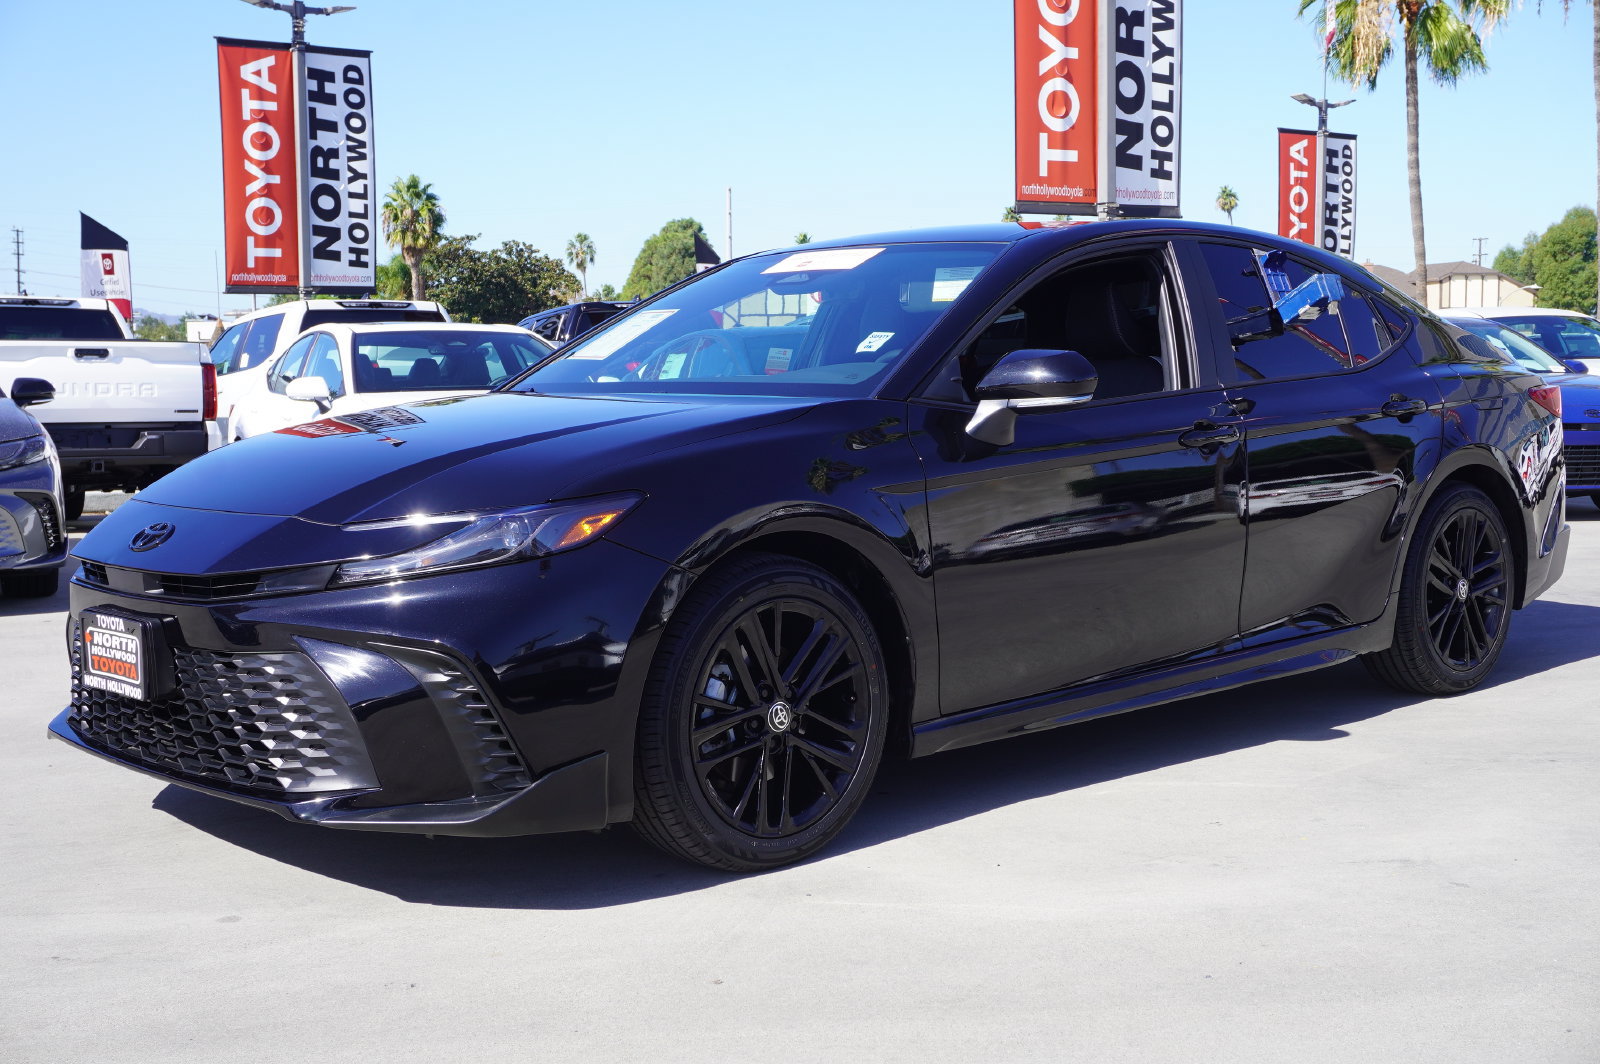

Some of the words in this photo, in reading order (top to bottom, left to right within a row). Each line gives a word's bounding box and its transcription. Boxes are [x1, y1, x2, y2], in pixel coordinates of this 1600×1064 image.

[240, 55, 283, 268] TOYOTA
[307, 67, 341, 262] NORTH
[343, 64, 370, 269] HOLLYWOOD
[1289, 138, 1308, 240] YOTA
[1324, 147, 1339, 253] ORTH
[1340, 144, 1353, 255] LLYWOOD
[56, 382, 158, 398] UNDRA
[91, 645, 136, 664] HOLLYWOOD
[93, 632, 137, 653] NORTH
[96, 614, 125, 632] TOYOTA
[84, 674, 106, 690] NORTH
[107, 680, 142, 700] HOLLYWOOD
[91, 655, 137, 680] TOYOTA
